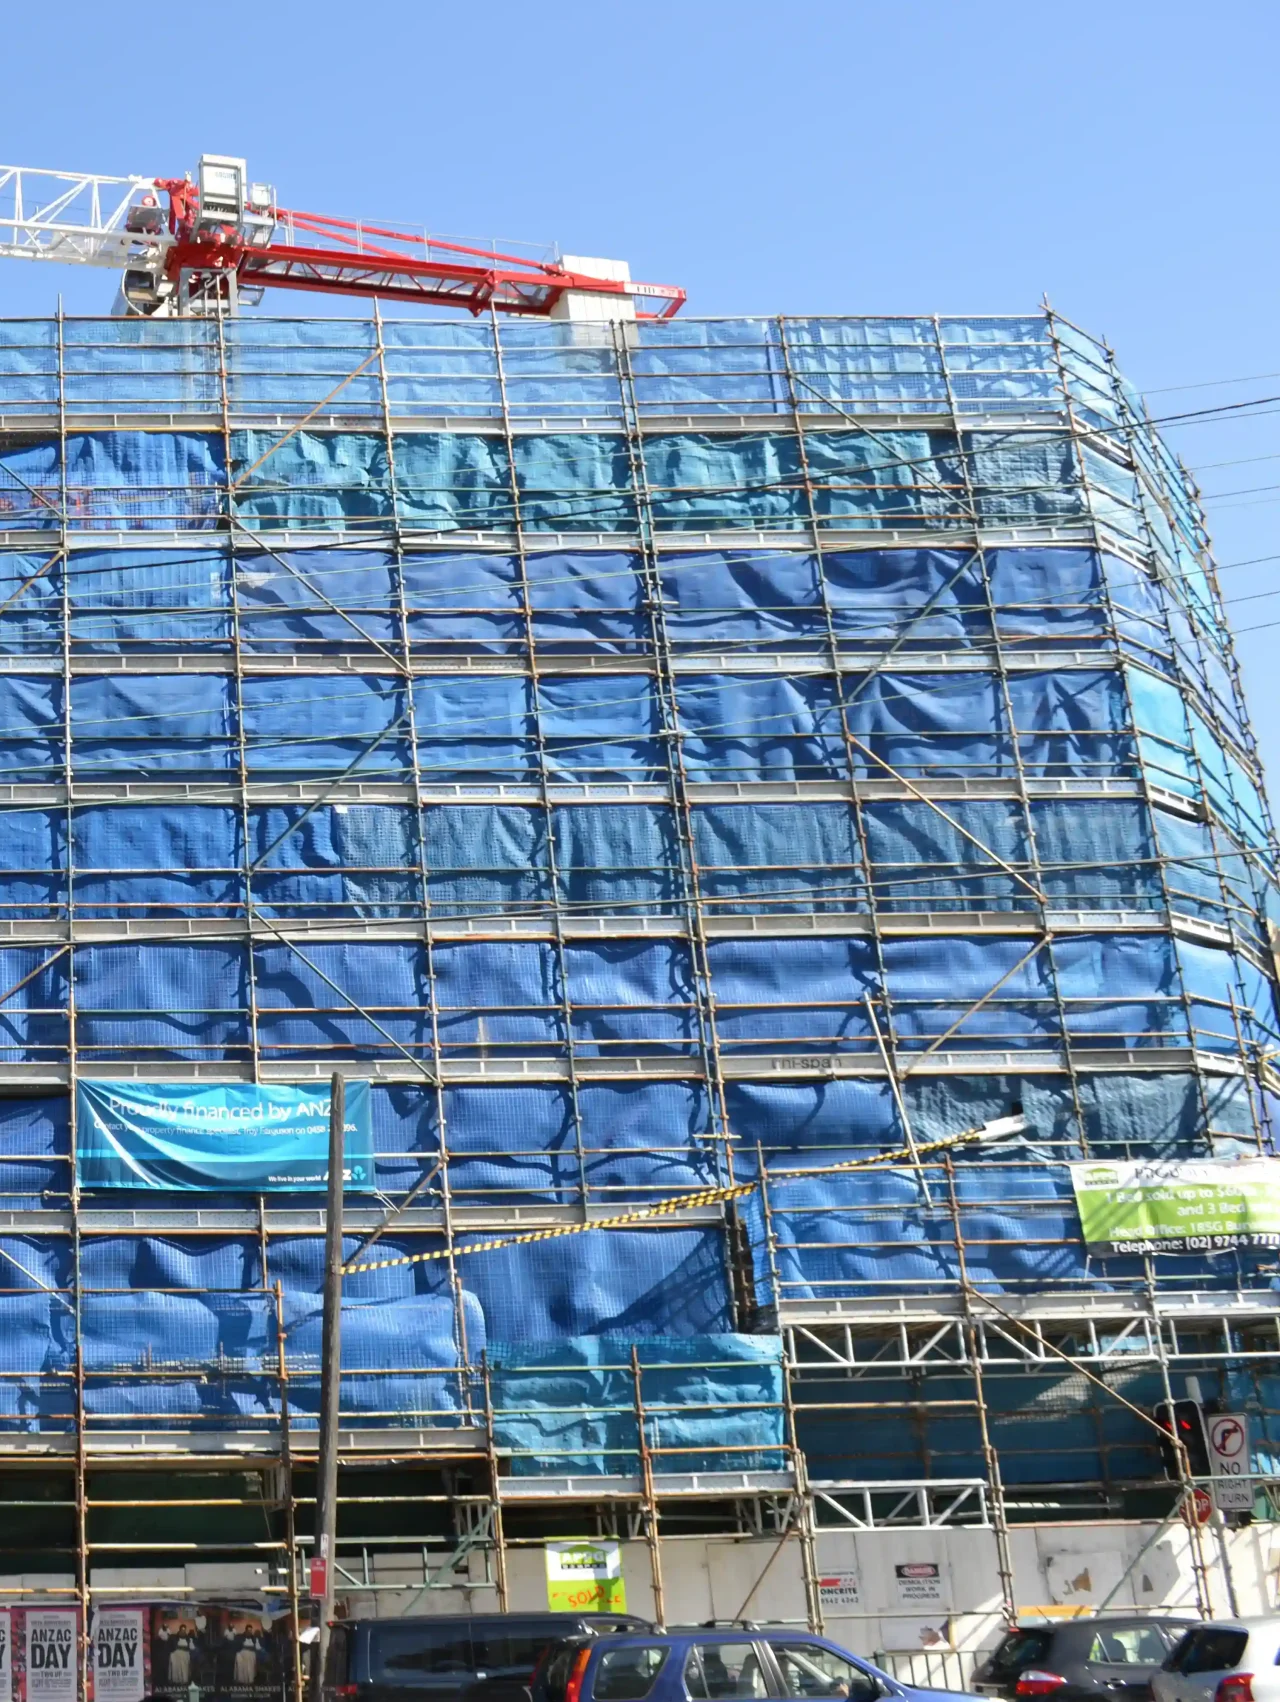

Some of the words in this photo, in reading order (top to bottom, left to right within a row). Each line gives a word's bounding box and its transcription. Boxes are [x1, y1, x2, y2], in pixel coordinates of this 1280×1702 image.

[109, 1098, 178, 1121] Proudly
[183, 1100, 264, 1120] financed
[268, 1102, 292, 1122] by
[1178, 1189, 1197, 1201] up
[1199, 1187, 1214, 1198] to
[1177, 1203, 1204, 1216] and
[1207, 1202, 1216, 1214] 3
[1219, 1202, 1246, 1214] Bed
[1111, 1237, 1183, 1254] Telephone:
[1185, 1236, 1212, 1250] (02)
[1214, 1233, 1249, 1248] 9744
[1221, 1461, 1241, 1475] NO
[1218, 1479, 1248, 1490] RIGHT
[1221, 1493, 1249, 1504] TURN
[568, 1585, 605, 1609] SOLD
[31, 1628, 72, 1642] ANZAC
[98, 1627, 139, 1641] ANZAC
[31, 1644, 72, 1668] DAY
[98, 1643, 139, 1667] DAY
[221, 1685, 254, 1693] ALABAMA
